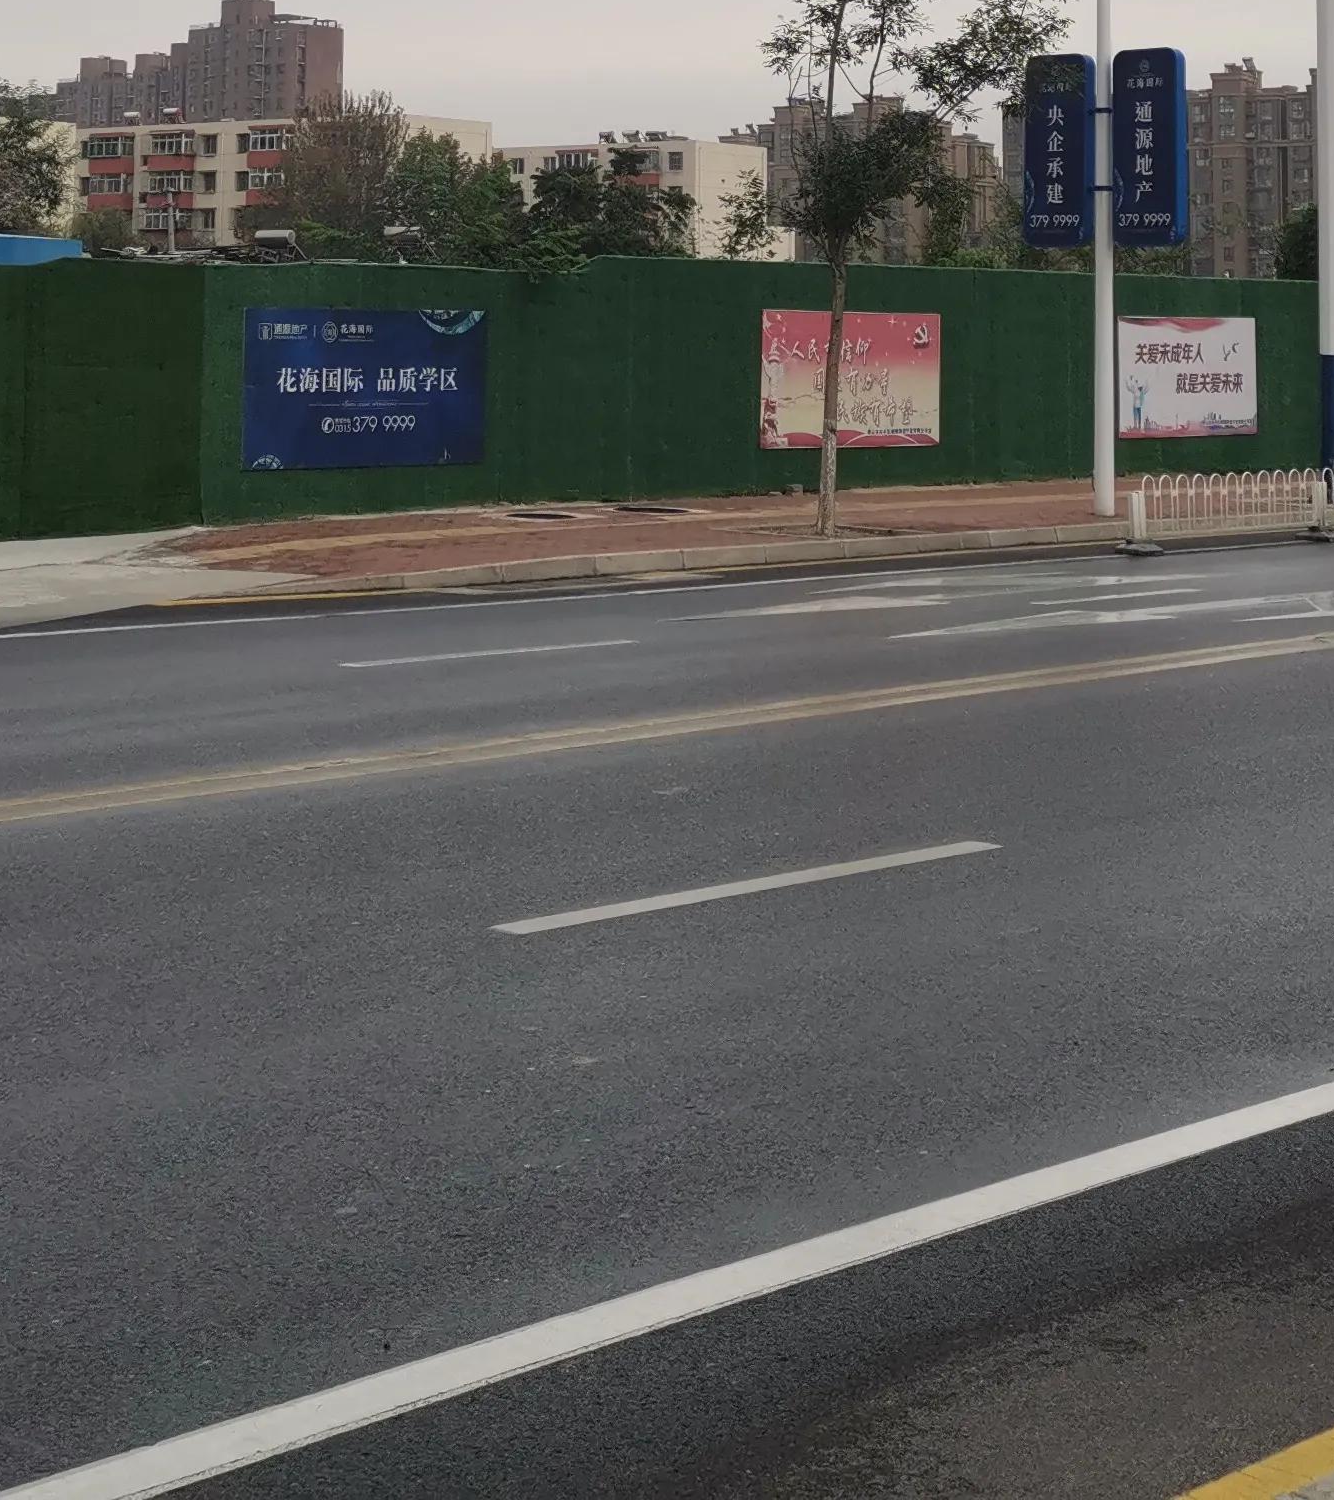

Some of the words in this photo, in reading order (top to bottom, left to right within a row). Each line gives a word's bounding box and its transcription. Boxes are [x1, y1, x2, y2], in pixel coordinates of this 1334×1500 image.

[1045, 104, 1065, 206] 央企承建
[1133, 100, 1155, 204] 通源地产
[1029, 214, 1049, 228] 379
[1052, 214, 1080, 228] 9999
[1118, 213, 1140, 227] 379
[1143, 213, 1171, 227] 9999
[791, 337, 870, 366] 人民信仰
[1134, 342, 1205, 365] 关爱未成年人
[276, 367, 365, 394] 花海国际
[376, 366, 459, 393] 品质学区
[1174, 372, 1244, 395] 就是关爱未来
[352, 415, 378, 433] 379
[382, 414, 416, 432] 9999
